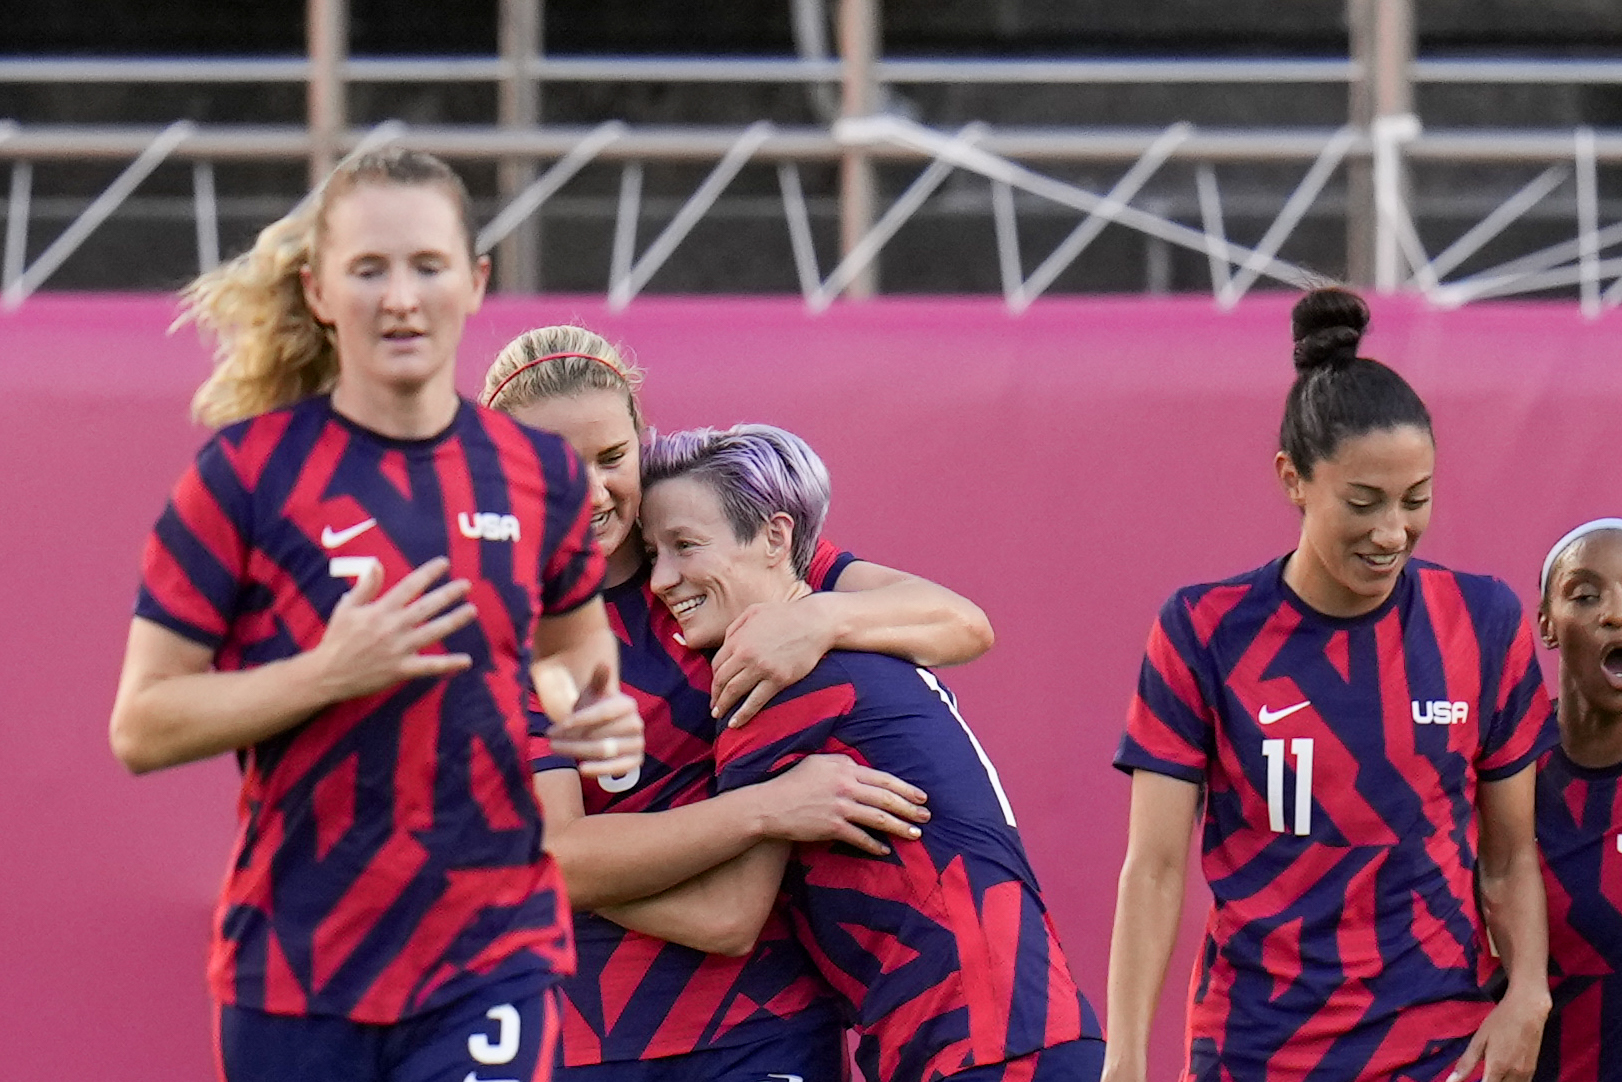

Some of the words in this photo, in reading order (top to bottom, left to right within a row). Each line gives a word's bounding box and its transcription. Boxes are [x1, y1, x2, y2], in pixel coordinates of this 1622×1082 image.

[457, 511, 522, 543] USA
[1411, 699, 1469, 725] USA
[1261, 737, 1314, 836] 11
